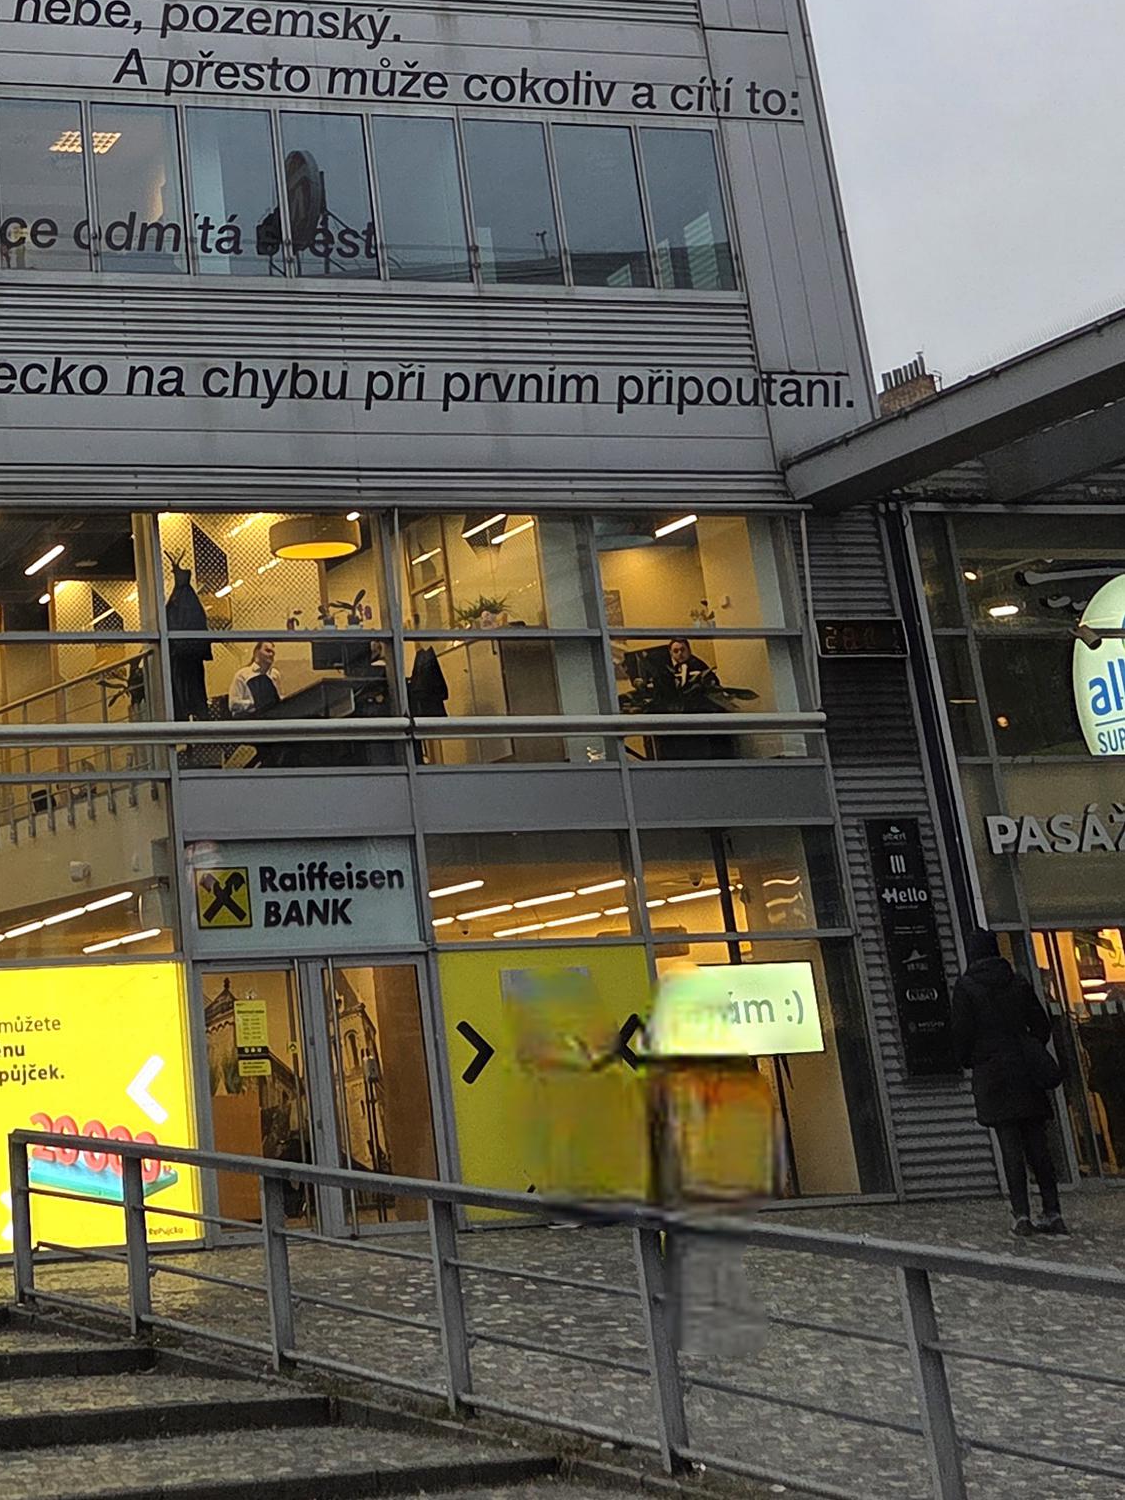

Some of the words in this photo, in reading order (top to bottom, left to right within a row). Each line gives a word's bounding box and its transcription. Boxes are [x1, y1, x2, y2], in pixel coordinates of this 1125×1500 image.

[160, 0, 402, 50] pozemský.
[112, 47, 149, 87] A
[163, 49, 311, 97] přesto
[327, 56, 450, 102] může
[463, 66, 617, 110] cokoliv
[631, 82, 658, 111] a
[669, 72, 734, 115] cítí
[745, 80, 801, 118] to:
[126, 363, 187, 398] na
[202, 360, 349, 410] chybu
[364, 362, 428, 412] při
[441, 364, 602, 413] prvním
[258, 861, 405, 894] Raiffeisen
[264, 897, 353, 929] BANK
